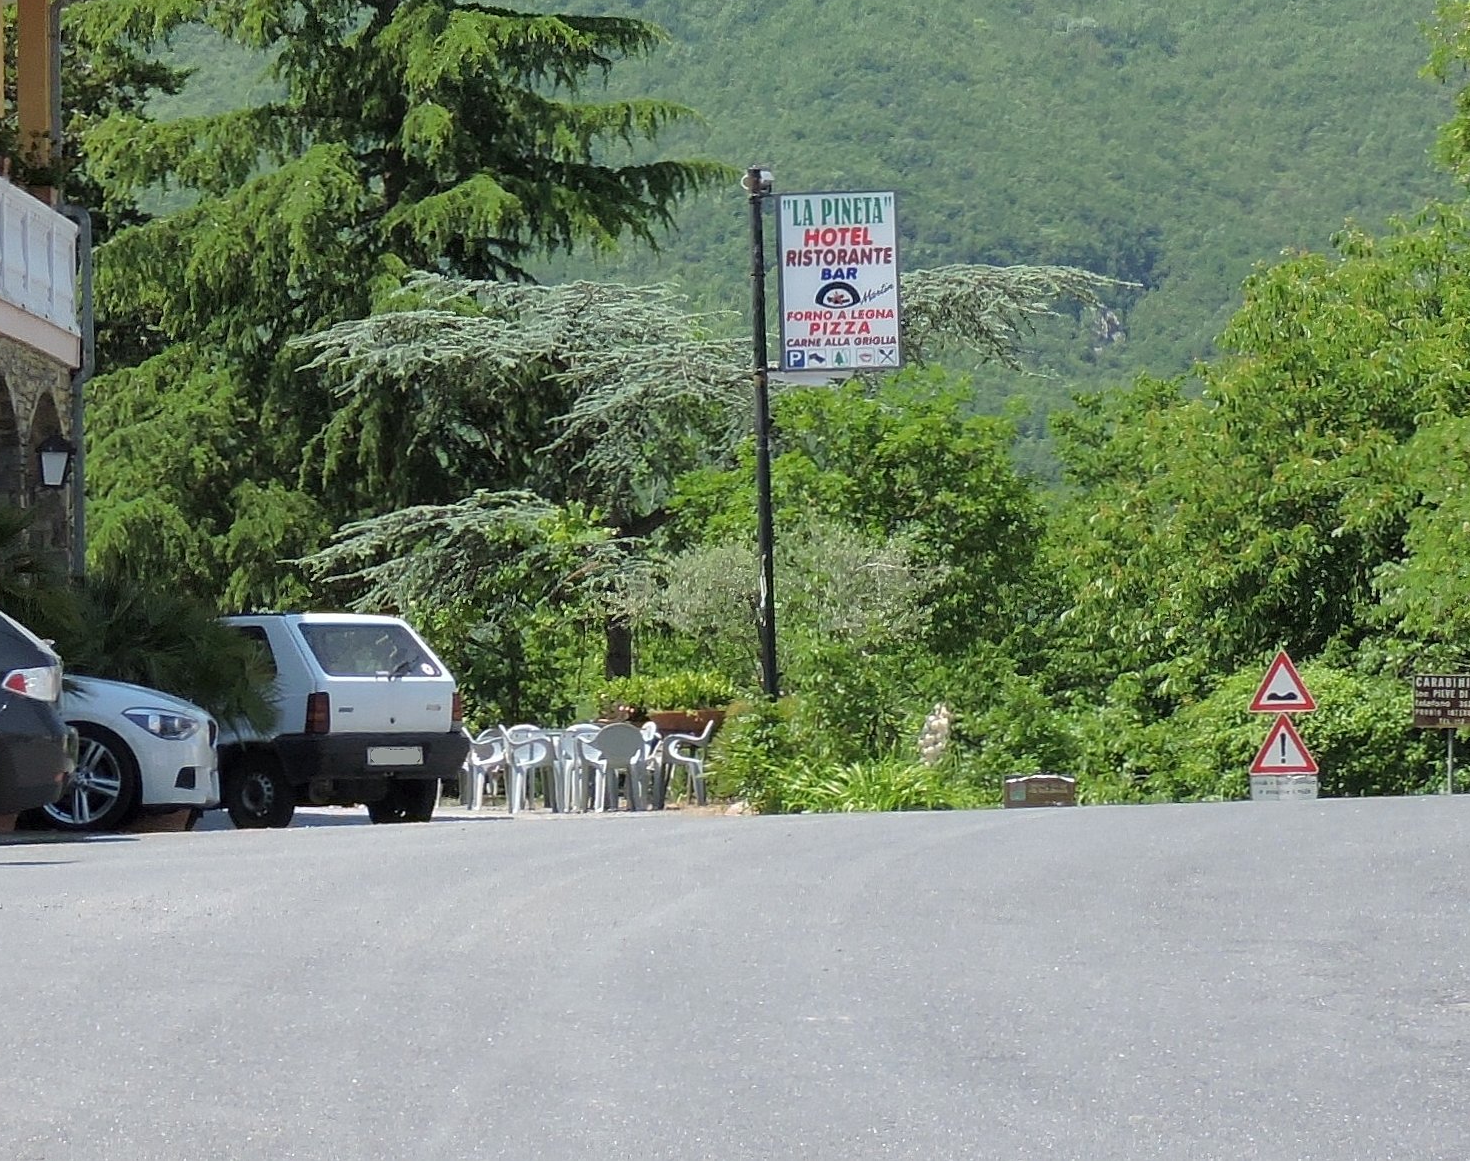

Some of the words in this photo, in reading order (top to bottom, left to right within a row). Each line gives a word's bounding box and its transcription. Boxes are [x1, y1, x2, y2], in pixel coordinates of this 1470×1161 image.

[804, 227, 873, 247] HOTEL
[786, 247, 892, 267] RISTORANTE
[821, 267, 858, 280] BAR
[786, 310, 833, 322] FORNO
[837, 310, 847, 320] A
[851, 308, 894, 320] LEGNA
[809, 321, 871, 336] PIZZA
[786, 338, 822, 348] CARNE
[824, 337, 850, 347] ALLA
[853, 336, 897, 347] GRIGLIA
[1459, 689, 1468, 699] DI
